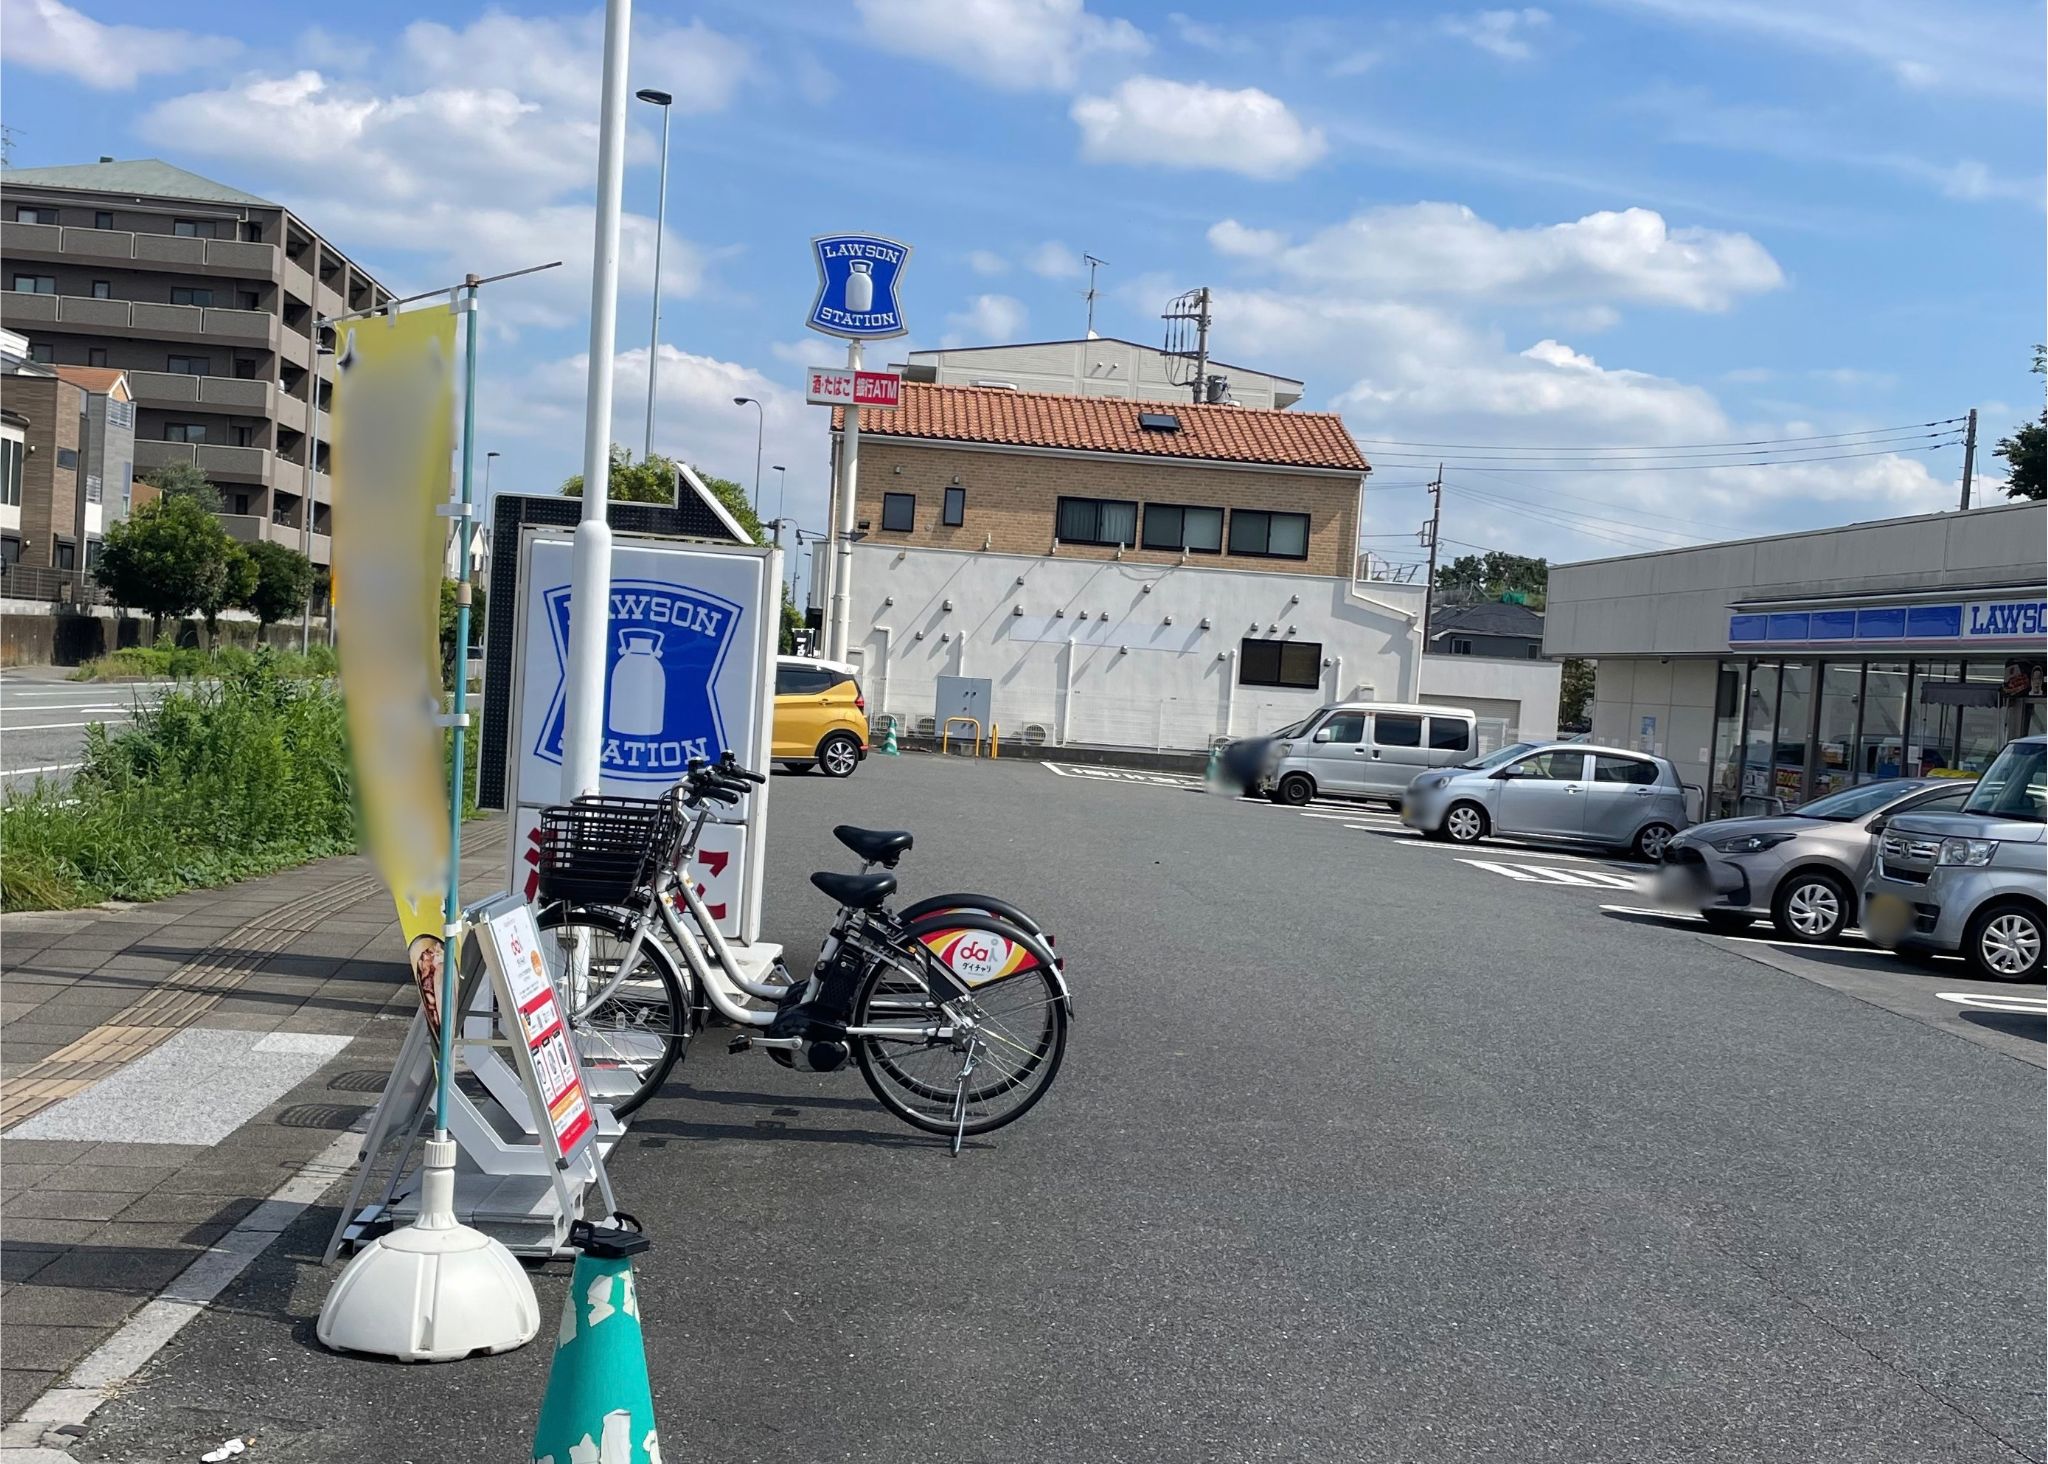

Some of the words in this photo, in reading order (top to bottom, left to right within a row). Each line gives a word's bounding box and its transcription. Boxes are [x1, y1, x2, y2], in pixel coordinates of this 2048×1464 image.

[824, 243, 900, 264] LAWSON
[820, 306, 896, 327] STATION
[856, 377, 897, 399] 銀行ATM
[960, 938, 999, 962] dai
